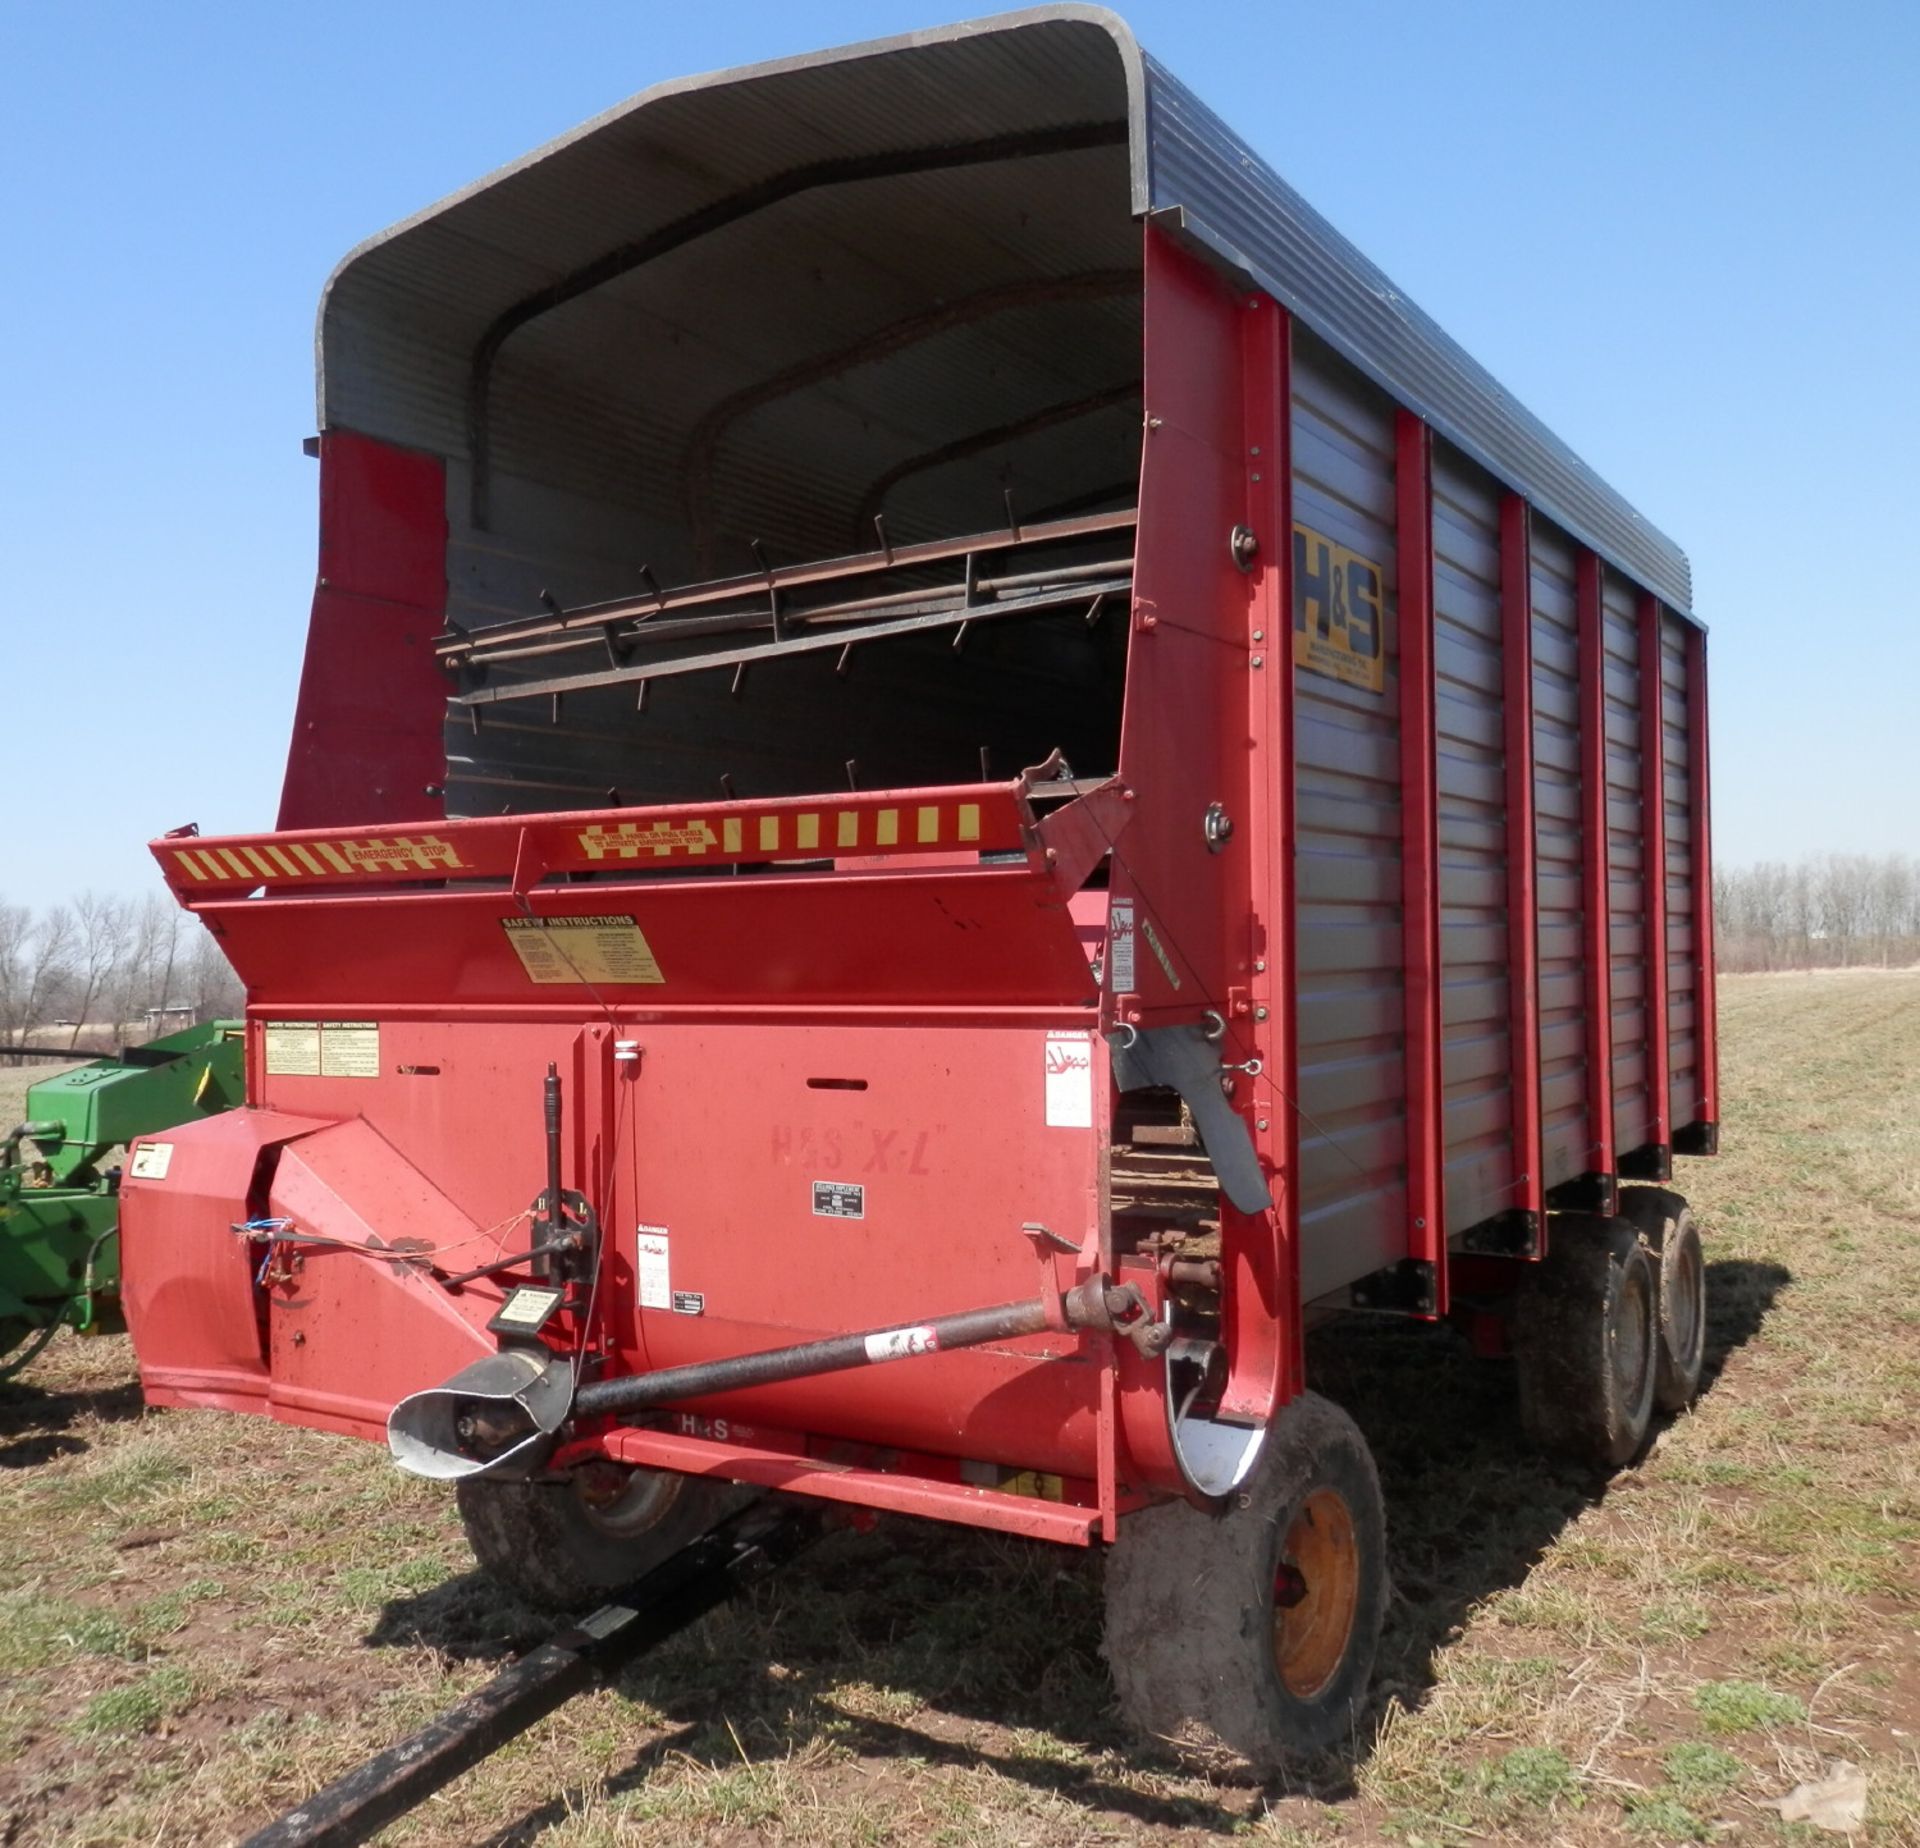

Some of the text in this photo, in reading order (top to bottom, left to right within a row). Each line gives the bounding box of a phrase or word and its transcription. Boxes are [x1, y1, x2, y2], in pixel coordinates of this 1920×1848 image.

[1294, 530, 1380, 660] H&S
[607, 833, 623, 841] THIS
[626, 832, 649, 840] PANEL
[649, 831, 660, 839] OR
[662, 831, 679, 839] PULL
[680, 829, 703, 838] CABLE
[606, 840, 638, 848] ACTIVATE
[639, 838, 682, 847] EMERGENCY
[684, 836, 704, 845] STOP
[352, 844, 448, 861] EMERGENCY STOP
[547, 915, 634, 927] INSTRUCTIONS
